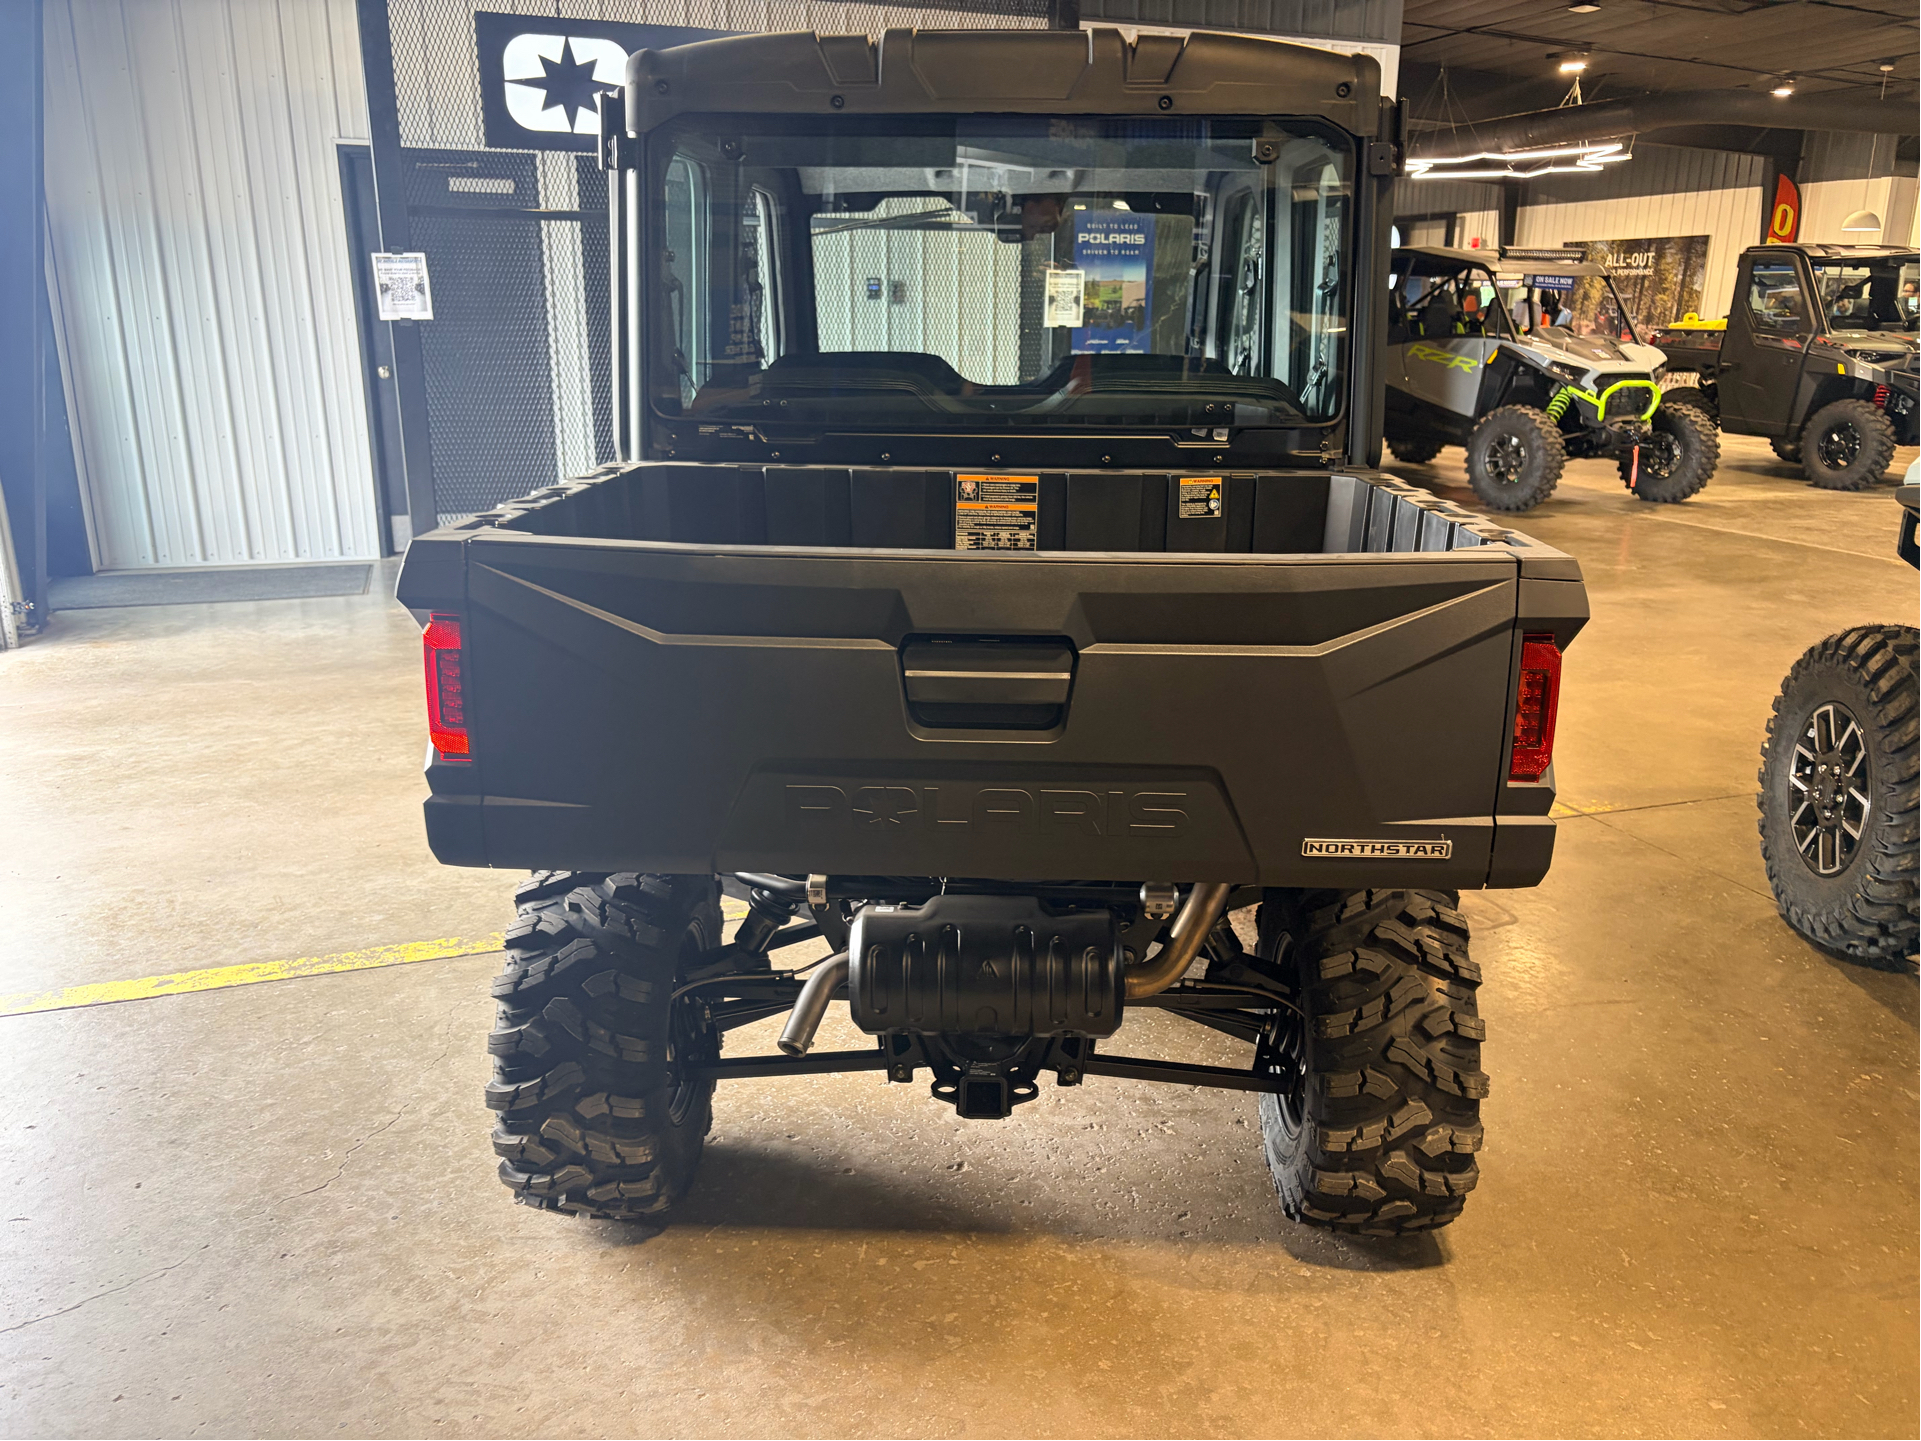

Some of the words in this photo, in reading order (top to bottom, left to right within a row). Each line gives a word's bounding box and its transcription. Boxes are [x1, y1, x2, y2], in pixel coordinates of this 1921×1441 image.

[1077, 233, 1146, 245] POLARIS
[1604, 252, 1656, 267] ALL-OUT
[1616, 268, 1654, 276] PERFORMANCE
[1535, 275, 1544, 283] ON
[1544, 276, 1559, 284] SALE
[1559, 277, 1574, 285] NOW
[1407, 344, 1478, 374] RZR
[785, 784, 1190, 838] POLARIS
[1308, 843, 1446, 856] NORTHSTAR
